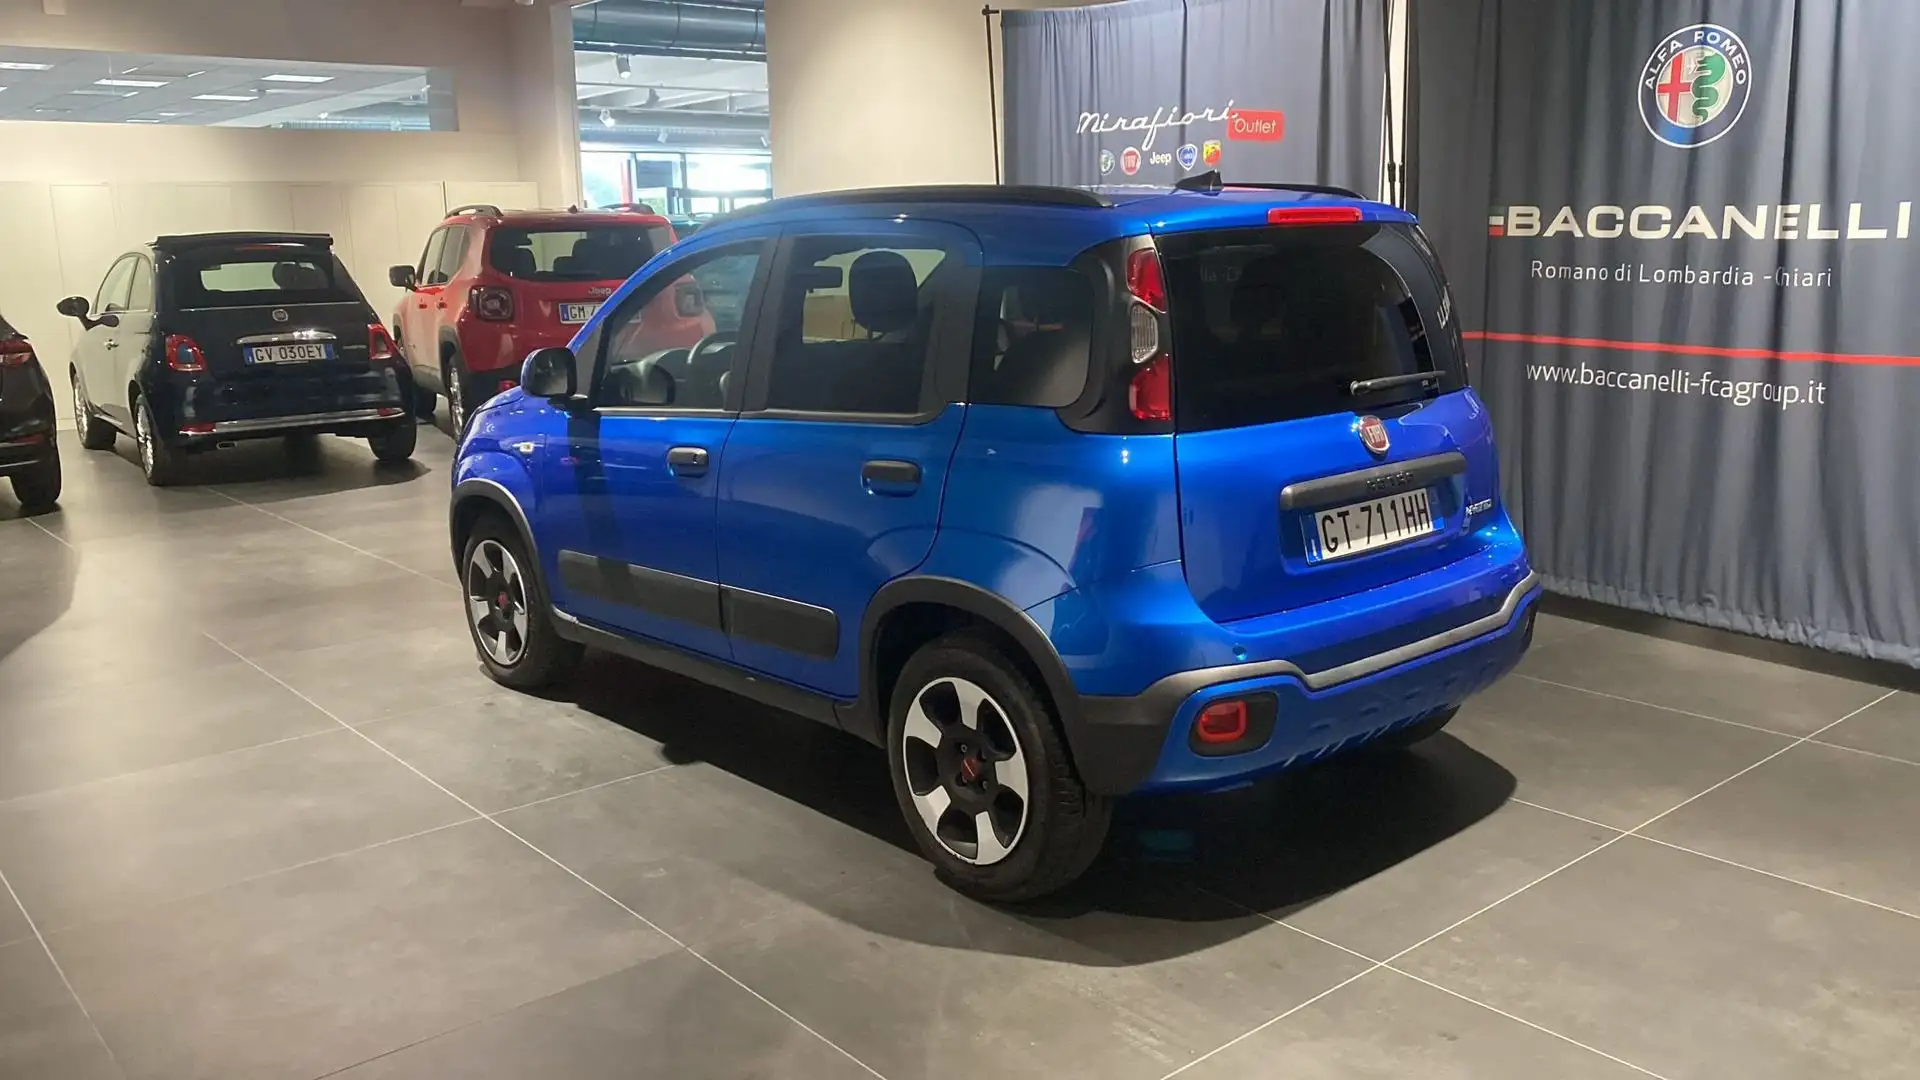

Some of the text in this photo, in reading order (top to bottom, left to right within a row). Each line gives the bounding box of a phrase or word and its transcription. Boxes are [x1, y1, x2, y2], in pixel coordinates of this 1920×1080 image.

[1645, 31, 1747, 89] ALFA ROMEO
[1234, 118, 1277, 134] Outlet
[1149, 151, 1172, 166] Jeep
[1506, 201, 1912, 240] BACCANELLI
[1531, 260, 1608, 282] Romano
[1614, 262, 1631, 282] di
[1639, 263, 1754, 286] Lombardia
[569, 305, 586, 319] GM
[254, 344, 324, 362] GV 030EY
[1526, 362, 1826, 410] www.baccanelli-fcagroup.it
[1321, 493, 1430, 553] GT 711HH
